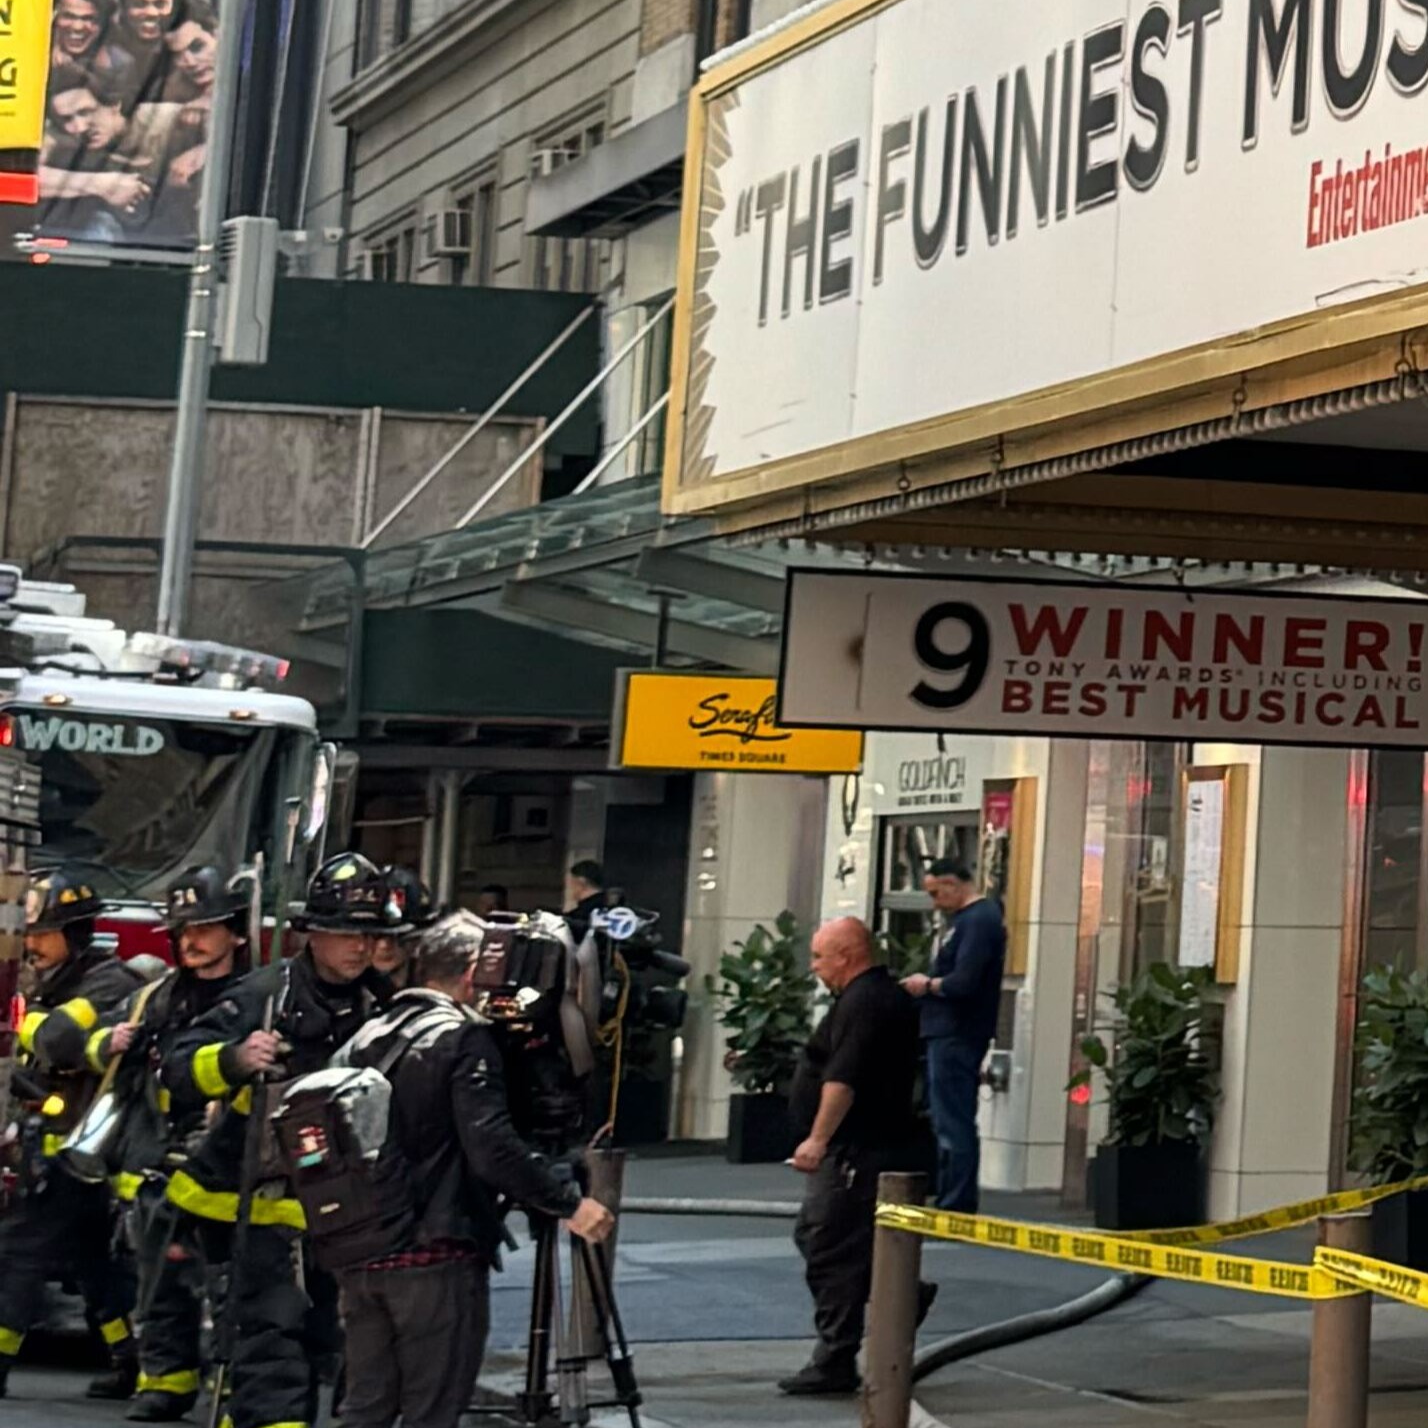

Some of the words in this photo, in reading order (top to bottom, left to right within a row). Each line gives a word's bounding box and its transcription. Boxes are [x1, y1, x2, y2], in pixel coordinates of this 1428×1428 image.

[908, 600, 990, 711] 9
[1007, 603, 1425, 673] WINNER!
[1003, 659, 1086, 678] TONY
[1258, 670, 1422, 693] INCLUDING
[1001, 678, 1146, 719] BEST
[1172, 685, 1420, 729] MUSICAL
[18, 714, 164, 755] WORLD
